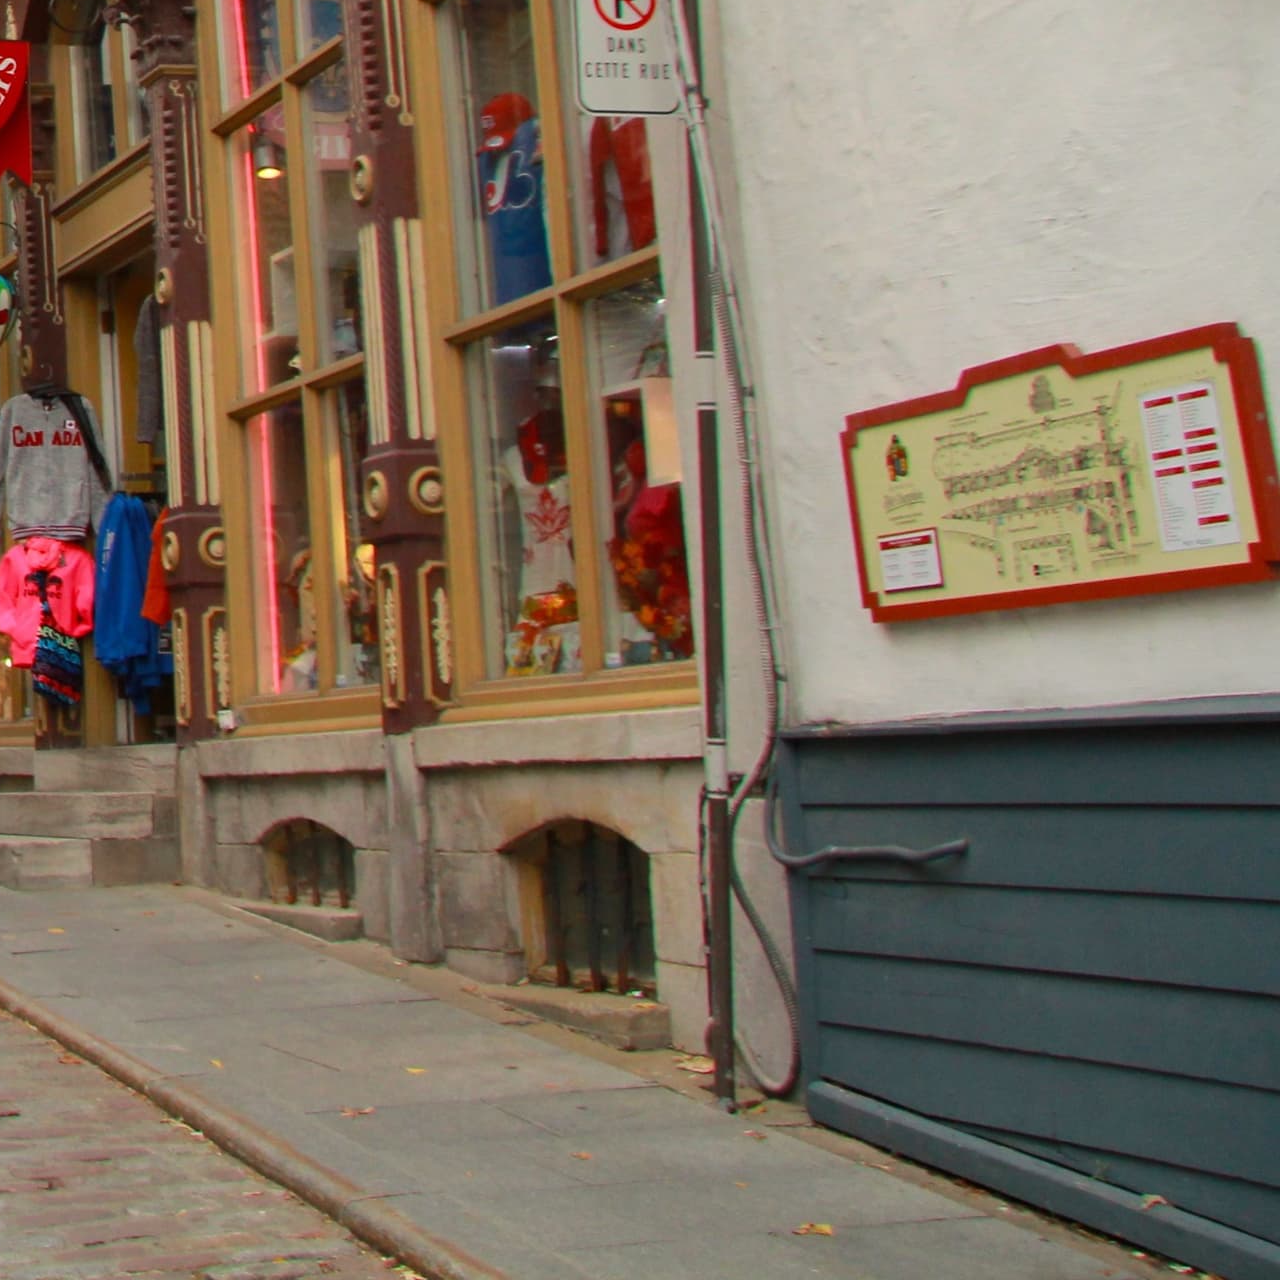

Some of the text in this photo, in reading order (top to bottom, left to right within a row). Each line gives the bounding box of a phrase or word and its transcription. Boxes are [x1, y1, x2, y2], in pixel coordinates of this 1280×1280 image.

[607, 37, 647, 53] DANS
[584, 62, 672, 80] CETTE RUE
